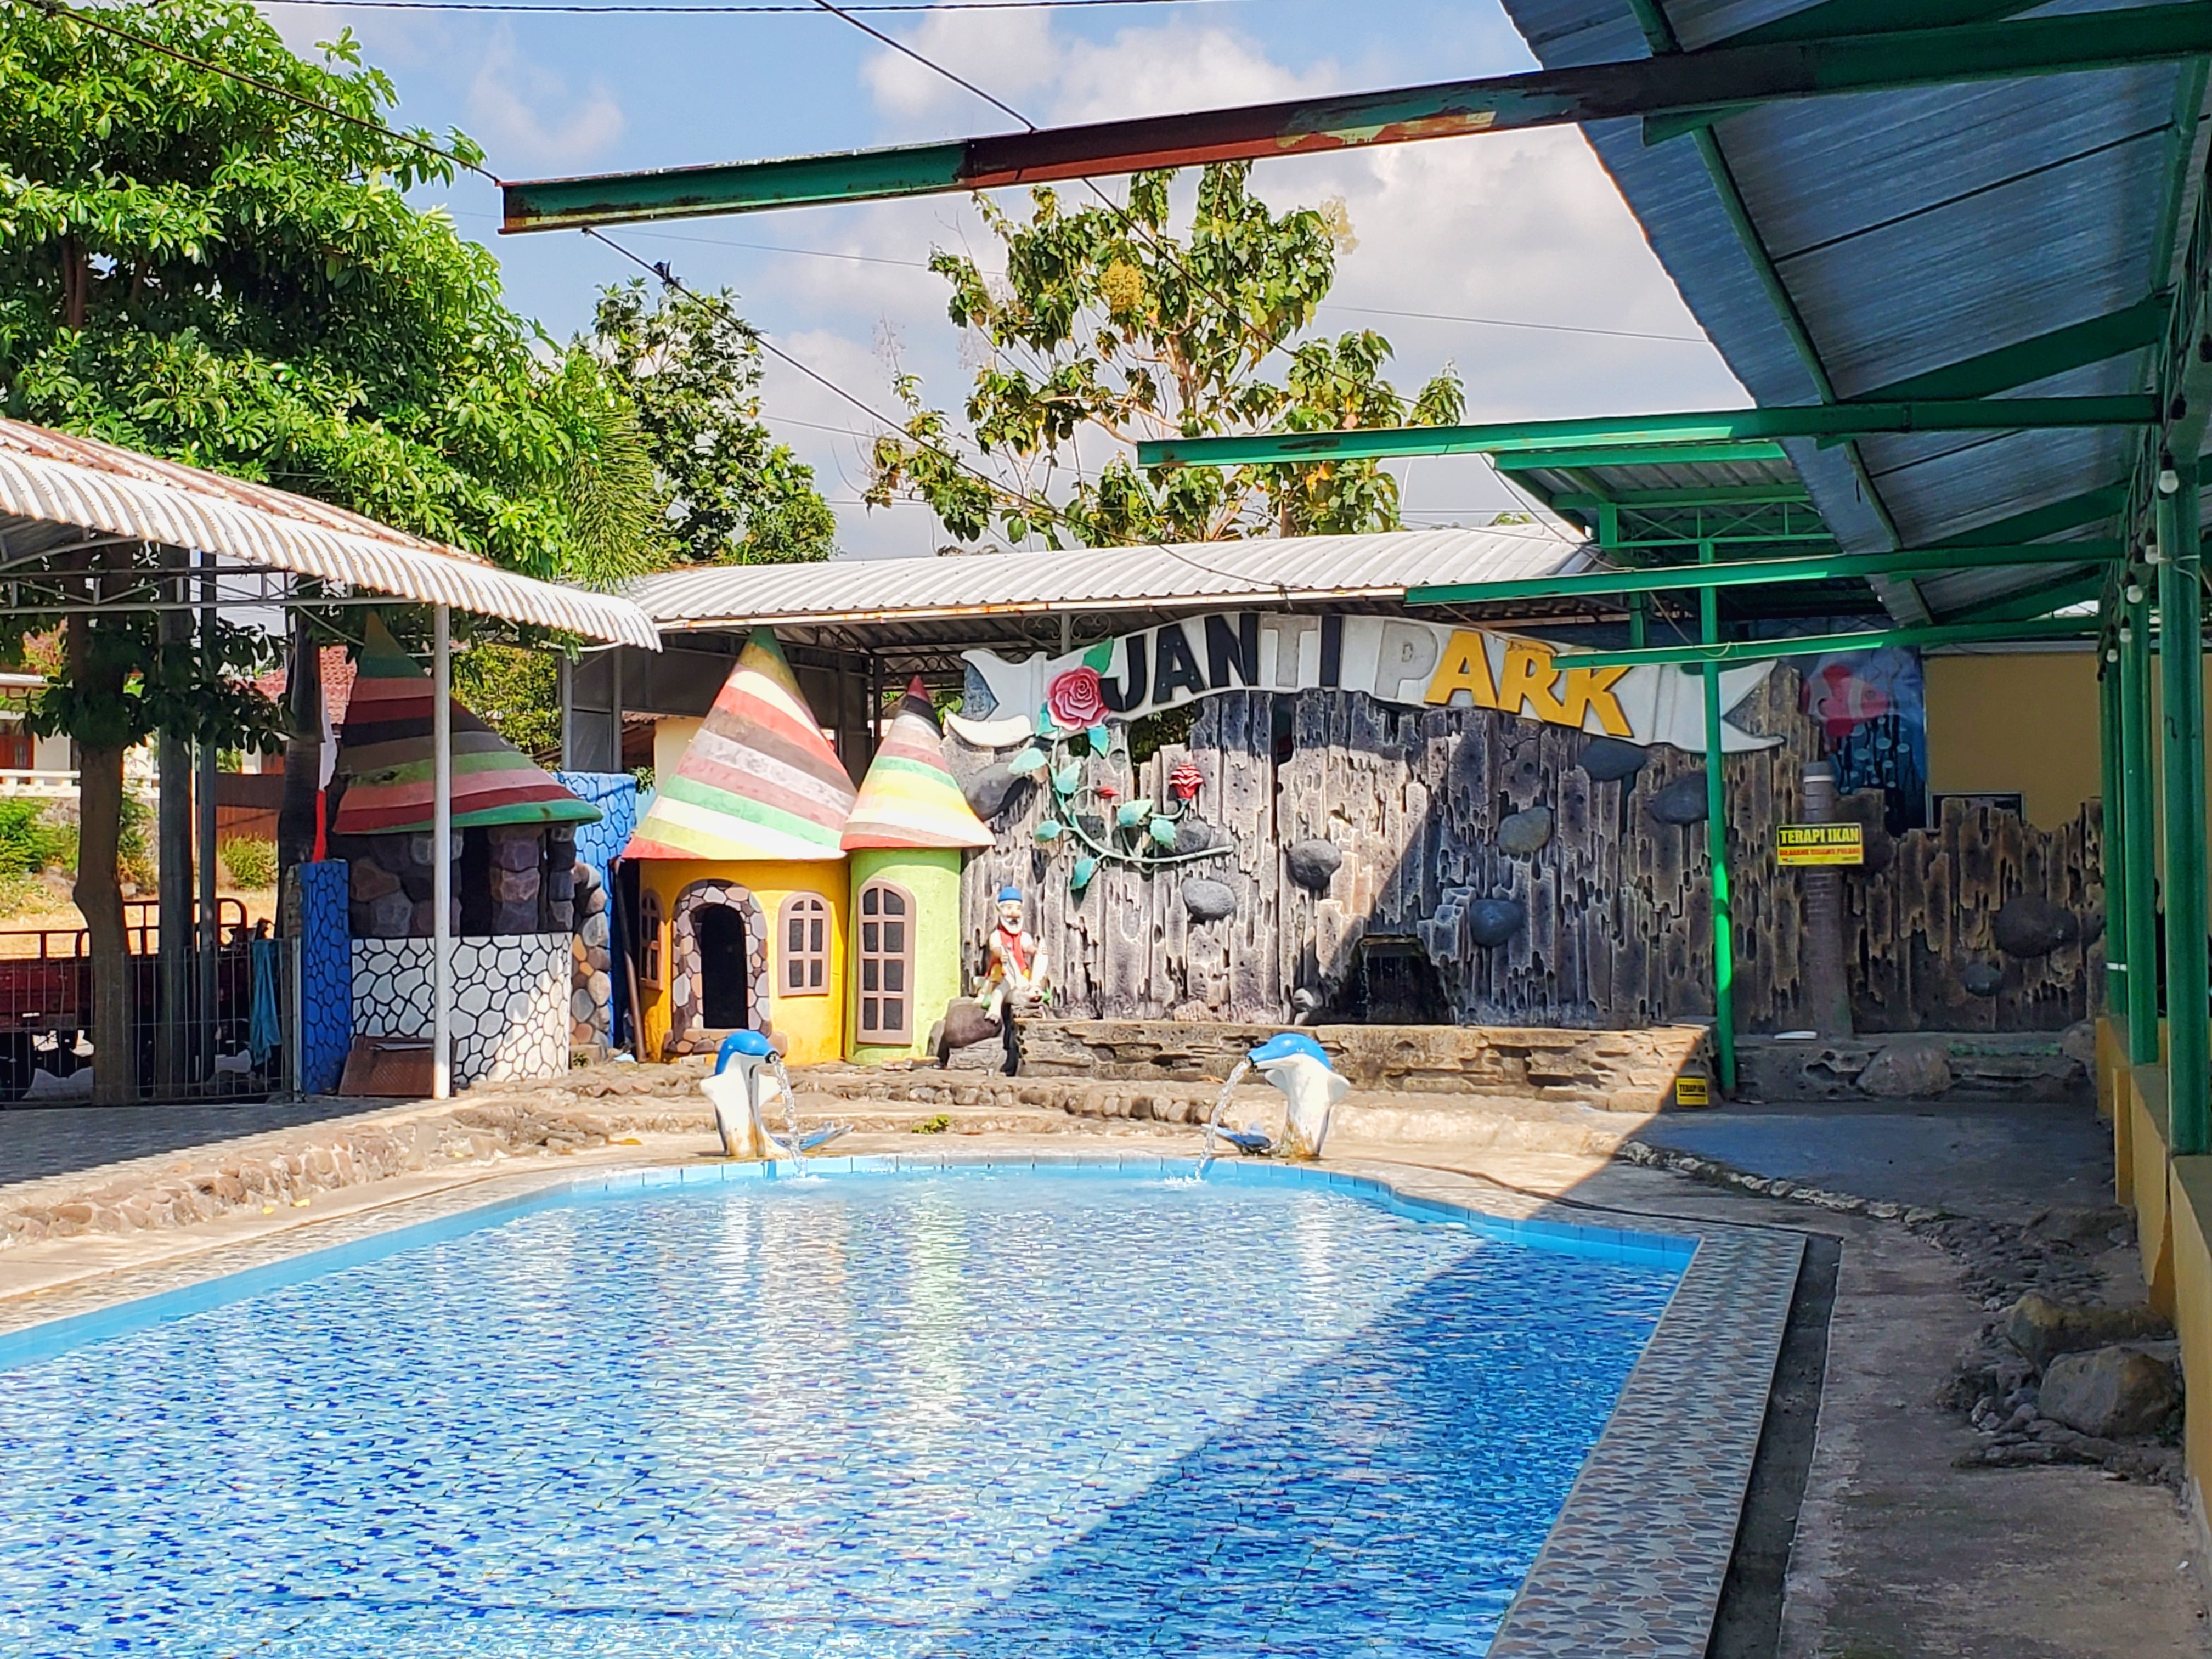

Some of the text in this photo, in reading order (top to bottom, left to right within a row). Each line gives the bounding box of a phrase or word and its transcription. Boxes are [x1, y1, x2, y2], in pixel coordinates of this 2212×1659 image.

[1100, 612, 1634, 737] JANTI PARK
[1780, 828, 1859, 844] TERAPI IKAN
